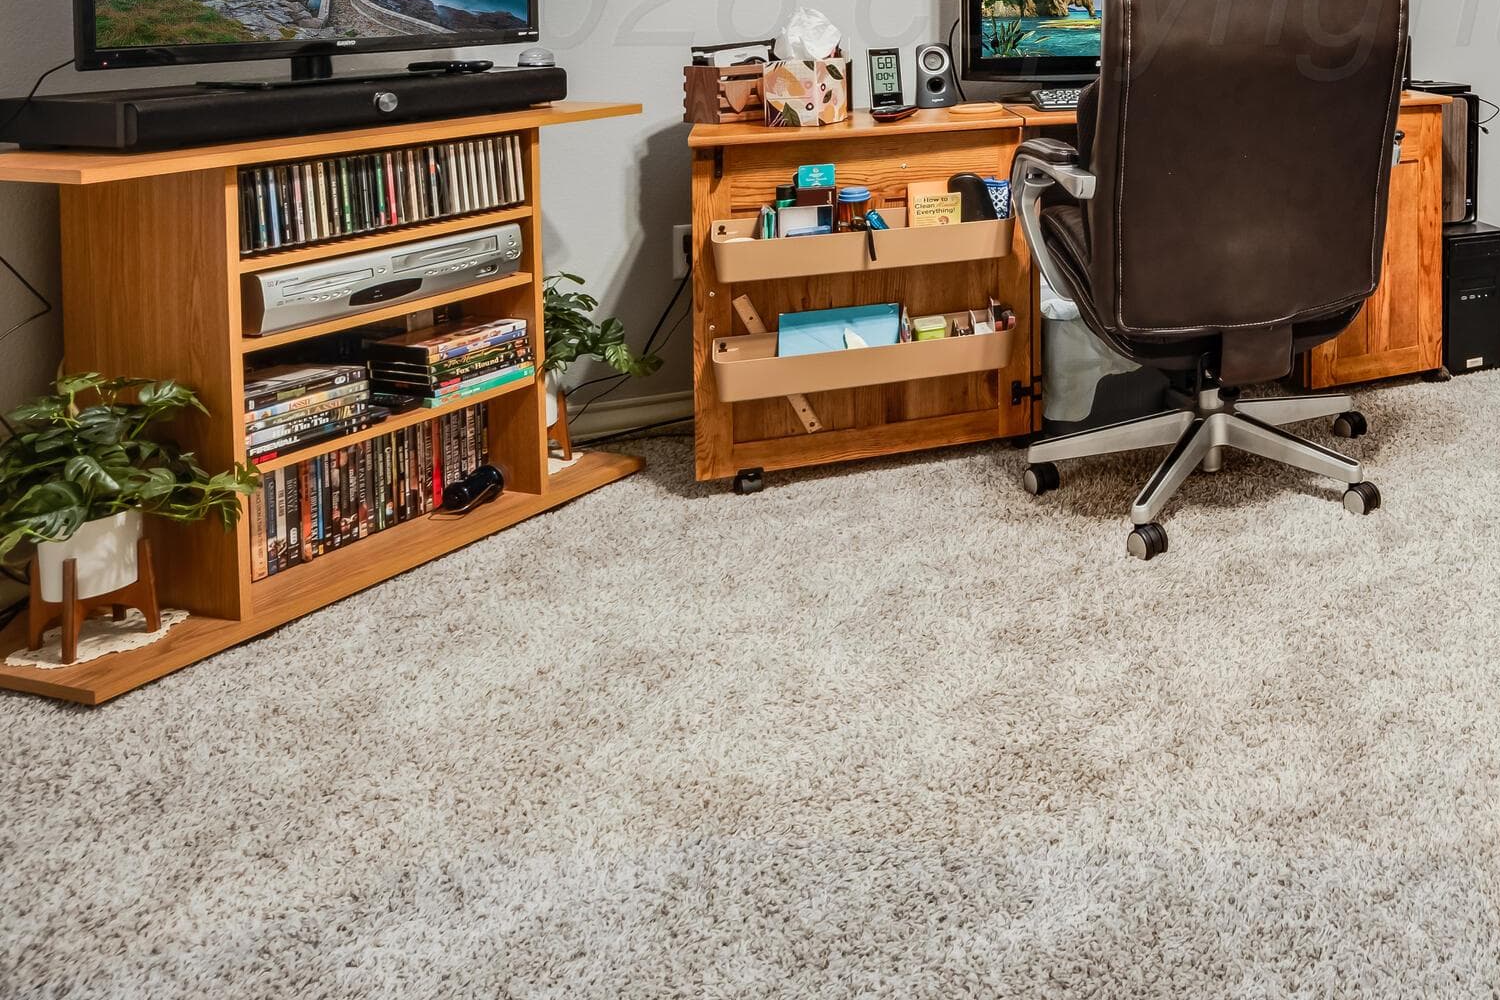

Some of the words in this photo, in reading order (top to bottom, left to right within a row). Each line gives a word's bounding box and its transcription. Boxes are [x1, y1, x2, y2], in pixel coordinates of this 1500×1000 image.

[916, 207, 956, 216] Everything!
[456, 366, 470, 376] Fox
[474, 357, 500, 370] Hound
[291, 421, 311, 432] Tin
